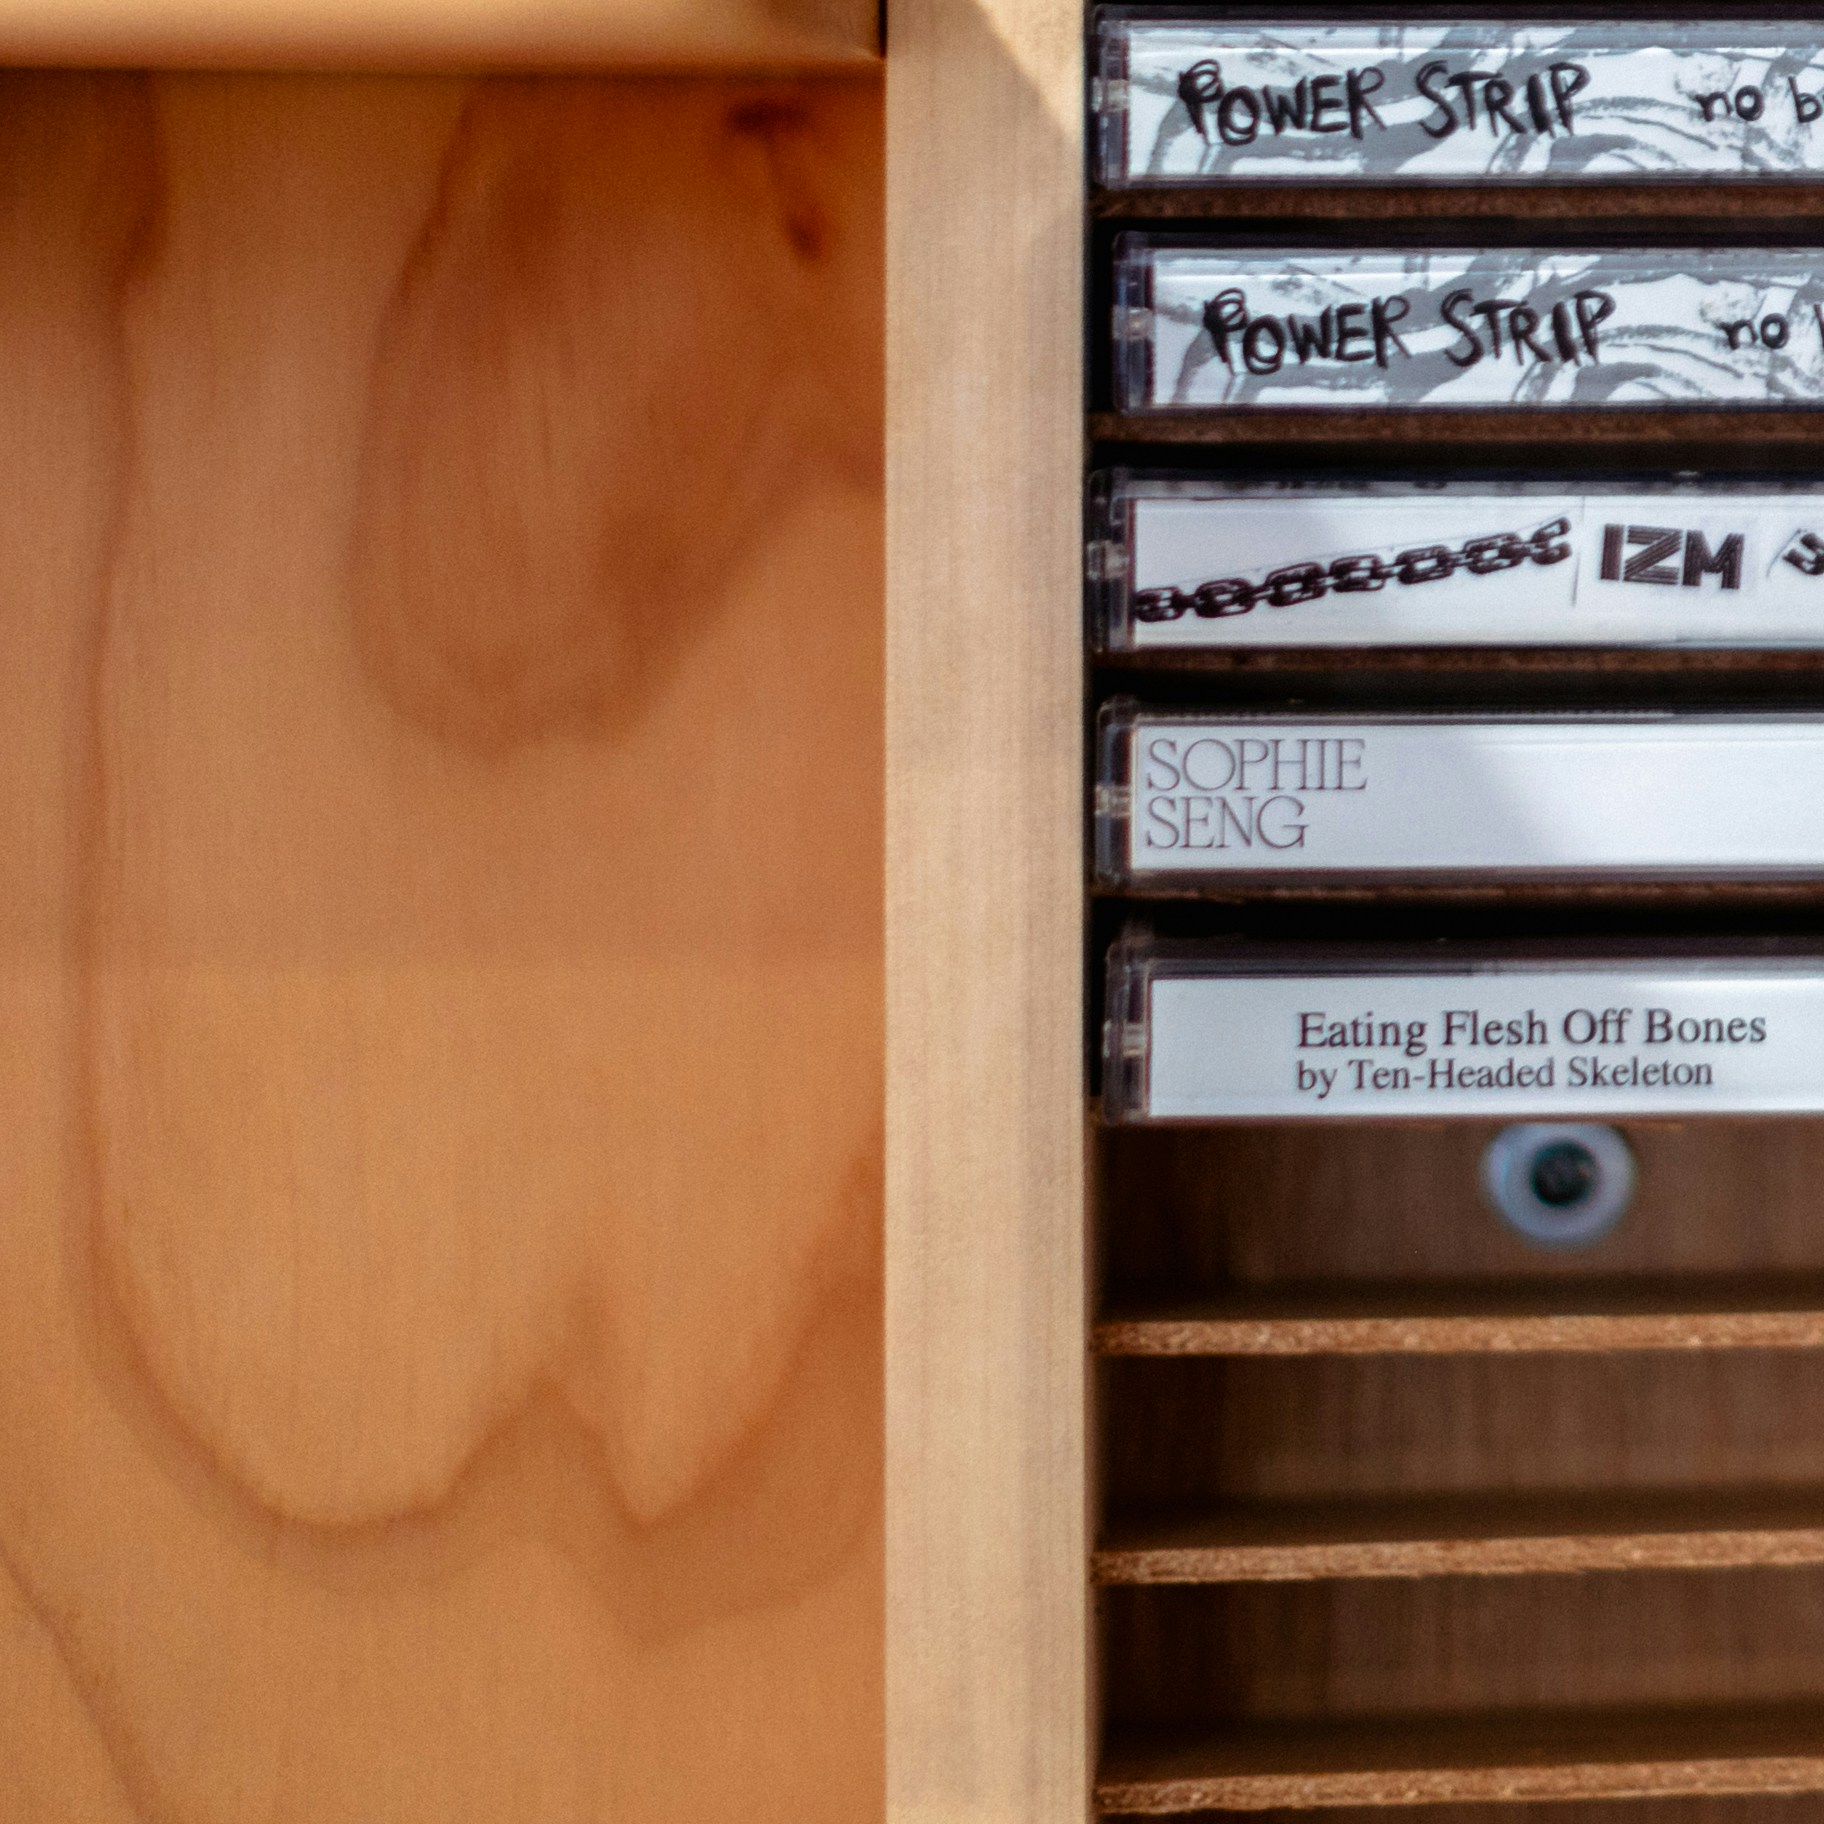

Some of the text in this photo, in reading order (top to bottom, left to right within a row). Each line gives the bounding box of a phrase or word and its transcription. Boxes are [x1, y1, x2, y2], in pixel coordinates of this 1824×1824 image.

[1179, 58, 1593, 146] POWER STRIP
[1697, 84, 1766, 123] no
[1203, 287, 1617, 376] POWER STRIP
[1721, 312, 1792, 351] no
[1600, 523, 1746, 589] IZM
[1146, 737, 1369, 792] SOPHIE
[1145, 794, 1310, 850] SENG
[1297, 1007, 1768, 1057] Eating Flesh Off Bones
[1297, 1055, 1714, 1099] by Ten-Headed Skeleton
